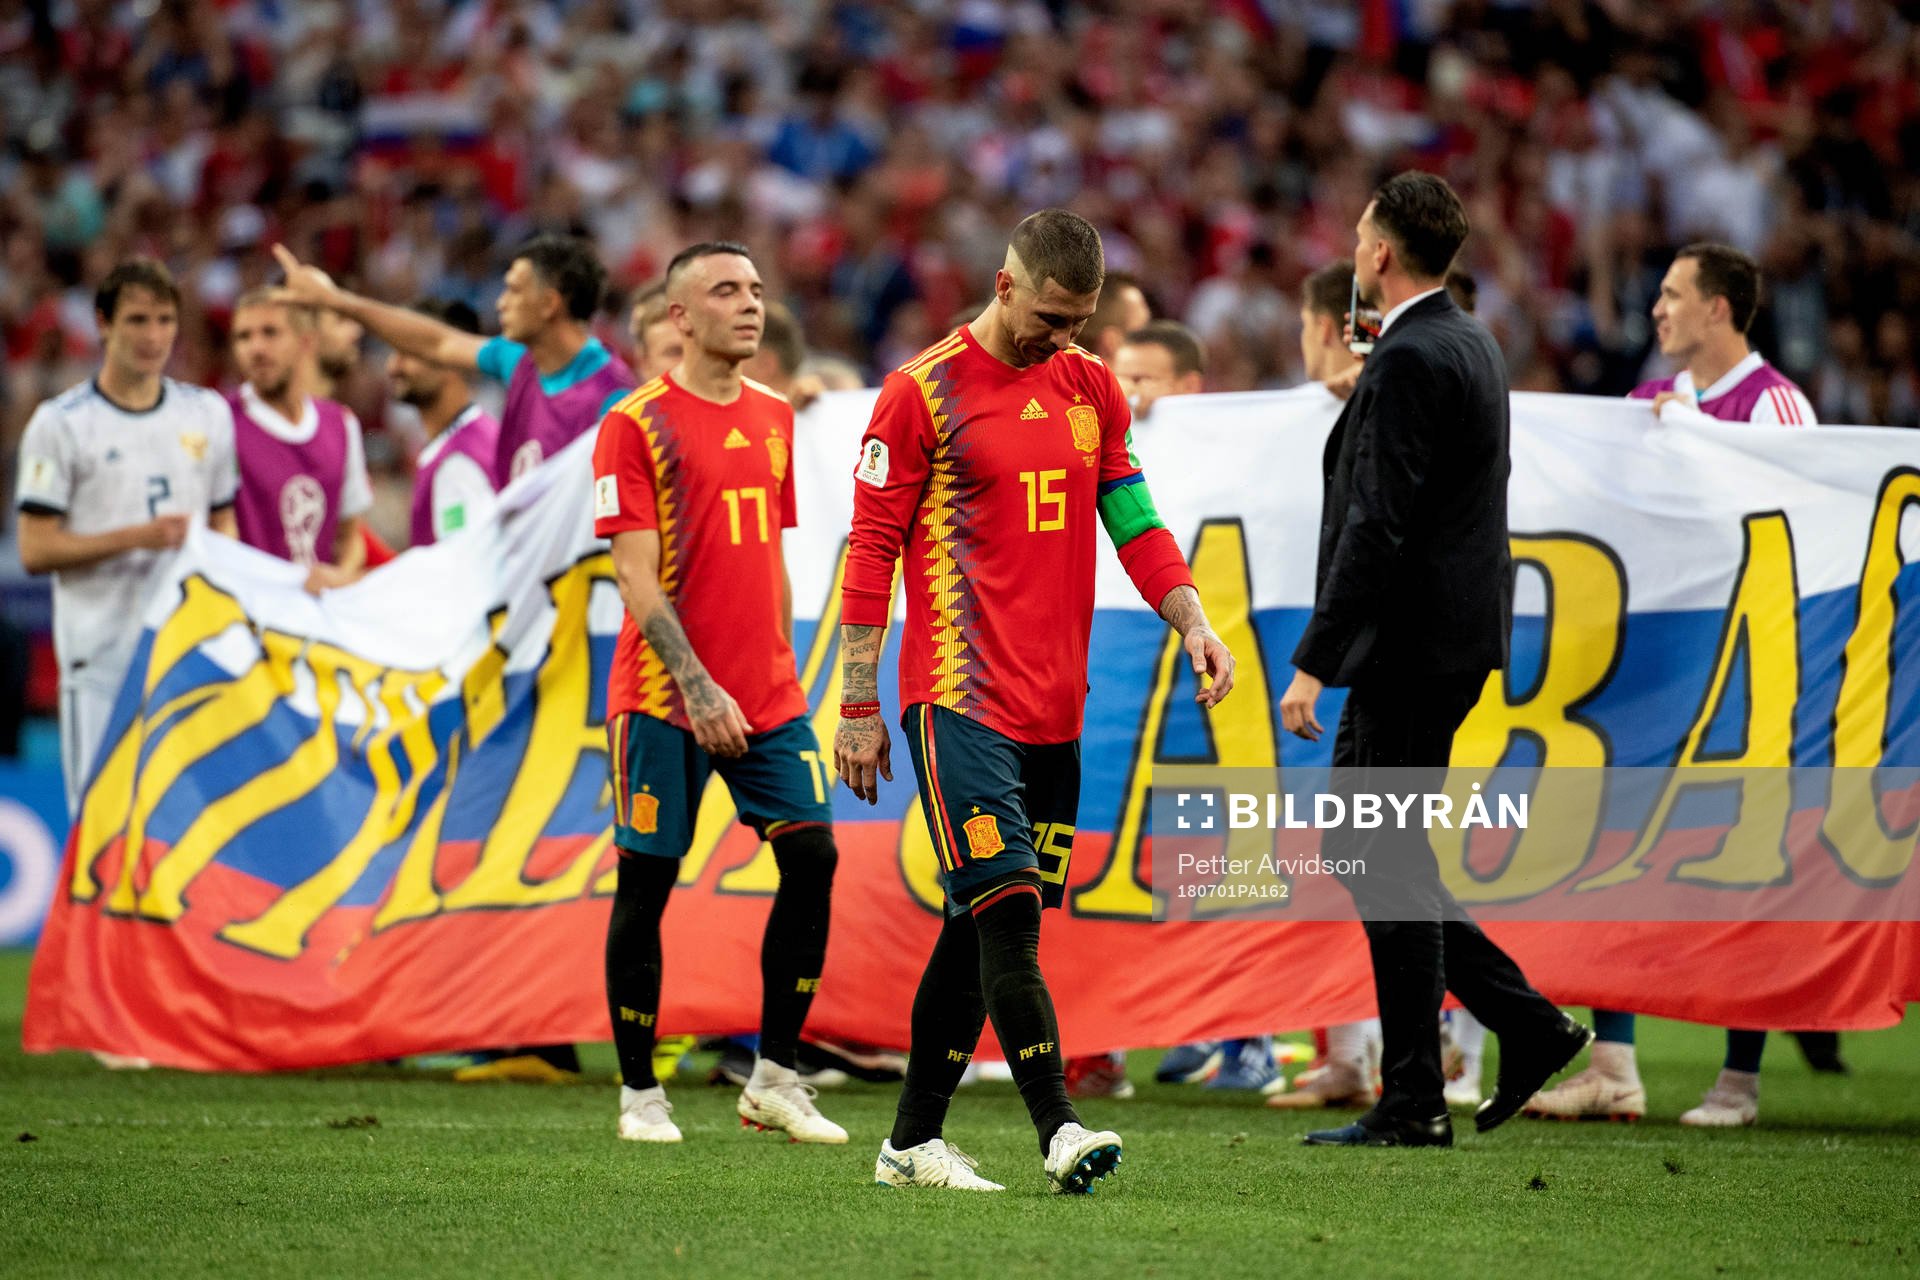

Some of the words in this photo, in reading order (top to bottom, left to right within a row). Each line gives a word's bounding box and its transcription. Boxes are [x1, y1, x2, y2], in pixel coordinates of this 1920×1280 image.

[146, 475, 171, 518] 2
[721, 487, 769, 545] 17
[1019, 468, 1067, 533] 15
[799, 750, 826, 804] 1
[796, 978, 821, 993] RFE
[947, 1048, 974, 1064] RFE
[1019, 1042, 1055, 1061] RFEF
